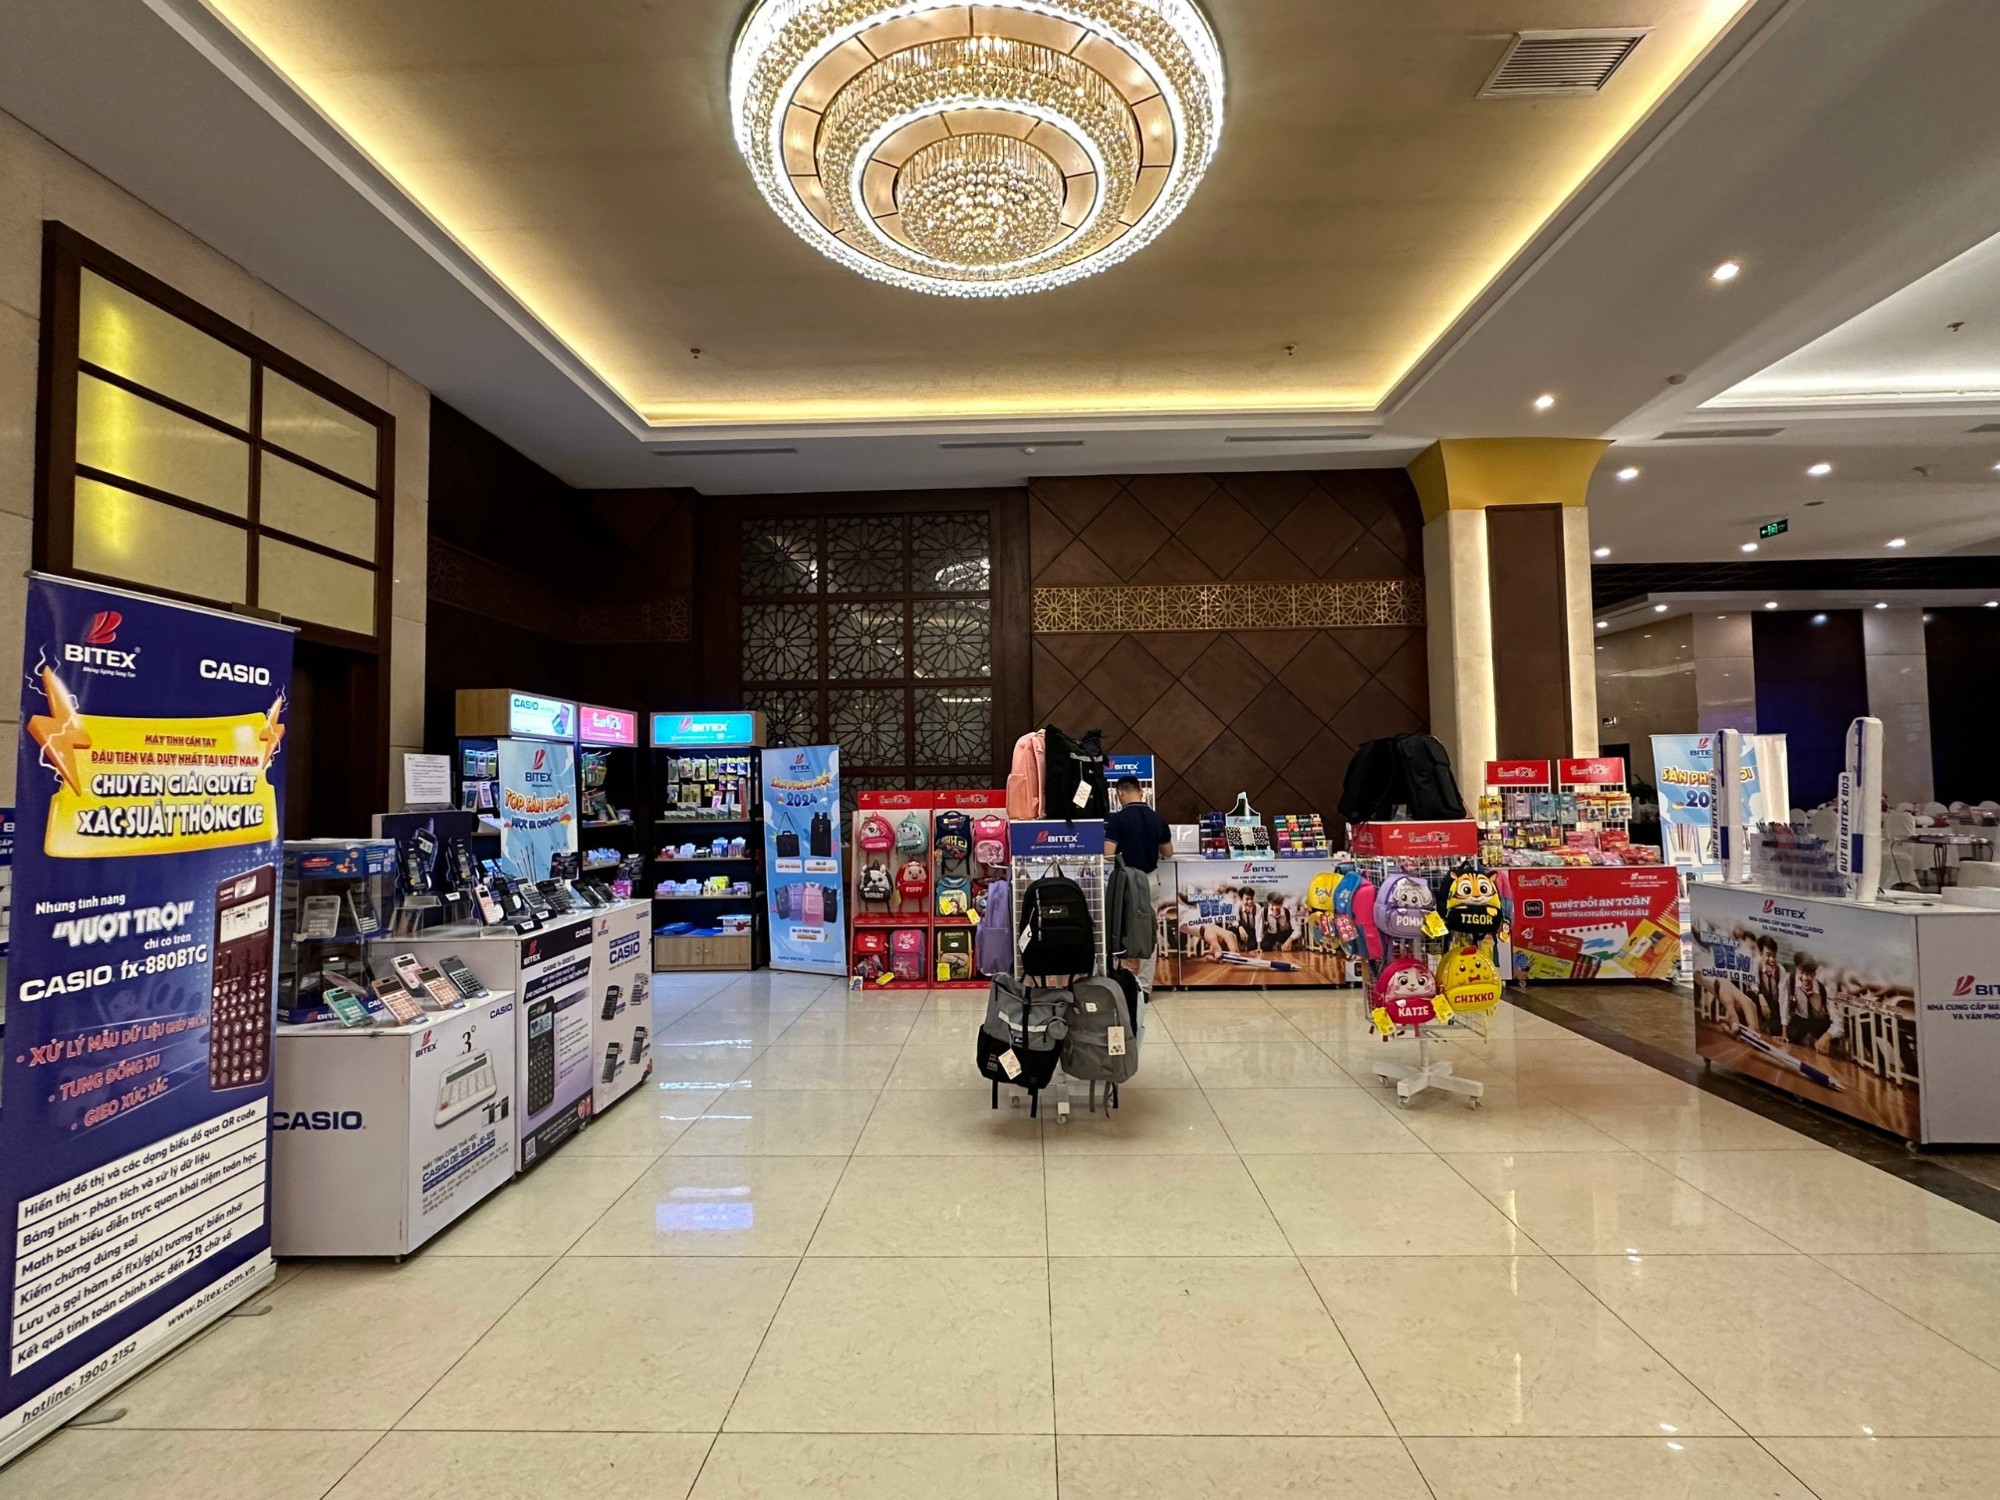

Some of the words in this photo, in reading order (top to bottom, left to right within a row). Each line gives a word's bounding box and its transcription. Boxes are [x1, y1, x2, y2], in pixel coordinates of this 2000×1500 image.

[65, 643, 136, 669] BITEX
[200, 659, 270, 685] CASIO
[514, 698, 539, 710] CASIO
[690, 723, 728, 732] BITEX
[202, 737, 217, 747] TAY
[91, 748, 113, 764] ĐẦU
[157, 752, 177, 765] DUY
[239, 755, 259, 767] NAM
[91, 771, 165, 797] CHUYÊN
[167, 771, 205, 797] GIẢI
[205, 771, 257, 797] QUYẾT
[525, 772, 552, 782] BITEX
[1662, 766, 1687, 784] SẢN
[505, 788, 525, 812] TOP
[786, 792, 818, 807] 2024
[77, 804, 124, 835] XÁC
[125, 799, 177, 836] SUẤT
[178, 798, 242, 835] THỐNG
[242, 802, 264, 828] KÊ
[1840, 800, 1849, 836] BITEX
[35, 900, 76, 915] Những
[77, 896, 99, 909] tính
[100, 894, 126, 906] năng
[636, 911, 649, 920] CASIO
[1774, 907, 1805, 919] BITEX
[1461, 913, 1493, 925] TIGOR
[1803, 925, 1824, 934] CASIO
[144, 937, 159, 950] chỉ
[160, 936, 172, 947] có
[173, 933, 191, 944] trên
[575, 927, 591, 938] CASIO
[523, 953, 541, 965] BITEX
[609, 941, 640, 964] CASIO
[19, 965, 112, 1002] CASIO
[120, 944, 207, 980] fx-880BTG
[1454, 992, 1494, 1003] CHIKKO
[489, 1003, 513, 1019] CASIO
[1398, 1006, 1430, 1017] KATIE
[29, 1038, 65, 1067] XỬ
[66, 1033, 85, 1058] LÝ
[88, 1029, 120, 1052] MẪU
[121, 1024, 142, 1045] DỮ
[142, 1021, 164, 1041] LIỆU
[415, 1043, 437, 1058] BITEX
[60, 1072, 103, 1101] TUNG
[105, 1059, 144, 1084] ĐỒNG
[144, 1054, 161, 1070] XU
[84, 1100, 119, 1127] GIEO
[121, 1086, 146, 1111] XÚC
[272, 1111, 362, 1130] CASIO
[24, 1198, 52, 1218] Hiển
[56, 1188, 71, 1202] thị
[90, 1173, 105, 1187] thị
[107, 1165, 120, 1180] và
[122, 1157, 141, 1175] các
[143, 1148, 168, 1164] dạng
[169, 1137, 189, 1153] biểu
[203, 1125, 220, 1138] qua
[221, 1117, 234, 1128] QR
[236, 1109, 256, 1123] code
[422, 1159, 450, 1182] CASIO
[23, 1225, 55, 1247] Bảng
[58, 1212, 80, 1230] tính
[89, 1197, 117, 1217] phân
[119, 1184, 138, 1200] tích
[141, 1177, 153, 1189] và
[155, 1171, 169, 1183] xử
[170, 1164, 178, 1177] lý
[180, 1159, 193, 1171] dữ
[194, 1152, 210, 1165] liệu
[21, 1252, 53, 1276] Math
[56, 1241, 77, 1258] box
[79, 1227, 103, 1246] biểu
[106, 1214, 129, 1232] diễn
[131, 1204, 152, 1220] trực
[154, 1192, 178, 1210] quan
[179, 1178, 198, 1196] khái
[200, 1170, 221, 1185] niệm
[222, 1160, 241, 1174] toán
[243, 1152, 257, 1164] học
[18, 1315, 44, 1335] Lưu
[46, 1304, 60, 1317] và
[63, 1291, 81, 1311] gọi
[83, 1279, 108, 1297] hàm
[110, 1266, 123, 1282] số
[124, 1245, 163, 1274] f(x)/g(x)
[164, 1231, 193, 1251] tương
[195, 1223, 206, 1235] tự
[206, 1213, 224, 1228] biến
[226, 1202, 243, 1217] nhớ
[20, 1283, 52, 1305] Kiểm
[54, 1262, 91, 1287] chứng
[93, 1245, 121, 1265] đúng
[123, 1234, 138, 1249] sai
[17, 1343, 39, 1364] Kết
[41, 1328, 64, 1349] quả
[66, 1315, 89, 1333] tính
[91, 1300, 117, 1319] toán
[119, 1280, 146, 1302] chính
[148, 1270, 165, 1286] xác
[167, 1258, 184, 1275] đến
[186, 1244, 202, 1263] 23
[204, 1238, 221, 1252] chữ
[222, 1228, 233, 1242] số
[167, 1265, 256, 1327] www.bitex.com.vn
[22, 1382, 76, 1424] hotline:
[79, 1360, 108, 1385] 1900
[110, 1341, 137, 1366] 2152
